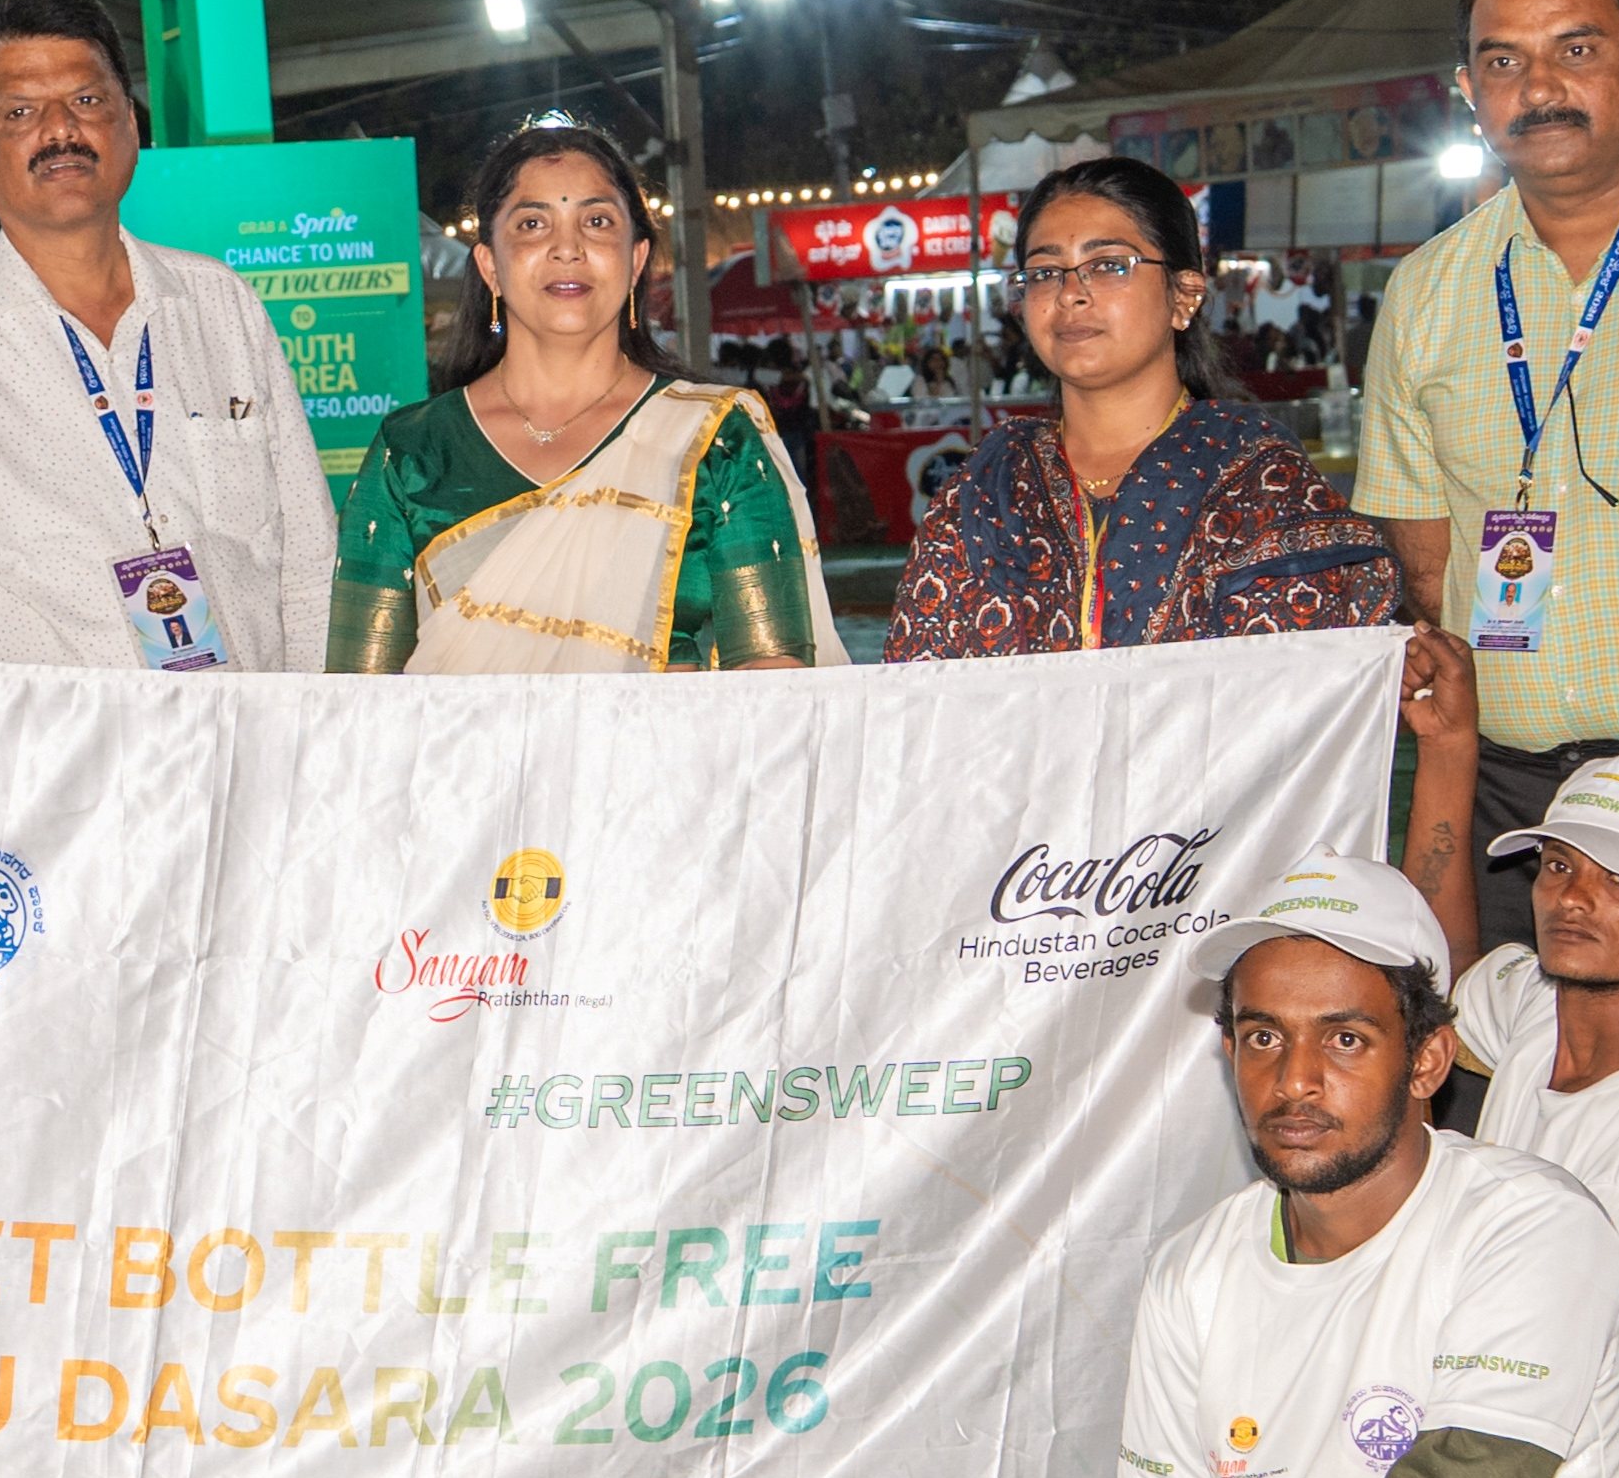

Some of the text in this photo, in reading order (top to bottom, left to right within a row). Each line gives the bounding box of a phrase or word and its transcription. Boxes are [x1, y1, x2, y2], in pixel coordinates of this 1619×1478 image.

[290, 207, 358, 239] Sprite
[308, 243, 333, 262] TO
[336, 241, 374, 260] WIN
[1585, 290, 1605, 322] 2026
[278, 332, 356, 364] OUTH
[291, 363, 359, 394] REA
[990, 826, 1223, 925] Coca-Cola
[959, 928, 1097, 961] Hindustan
[375, 928, 529, 1022] Sangam
[1023, 949, 1160, 986] Beverages
[477, 990, 613, 1009] Pratishthan (Regd.)
[485, 1056, 1032, 1130] #GREENSWEEP
[109, 1225, 550, 1314] BOTTLE
[590, 1219, 881, 1313] FREE
[55, 1358, 518, 1449] DASARA
[553, 1351, 832, 1445] 2026
[1120, 1445, 1174, 1477] ENSWEEP
